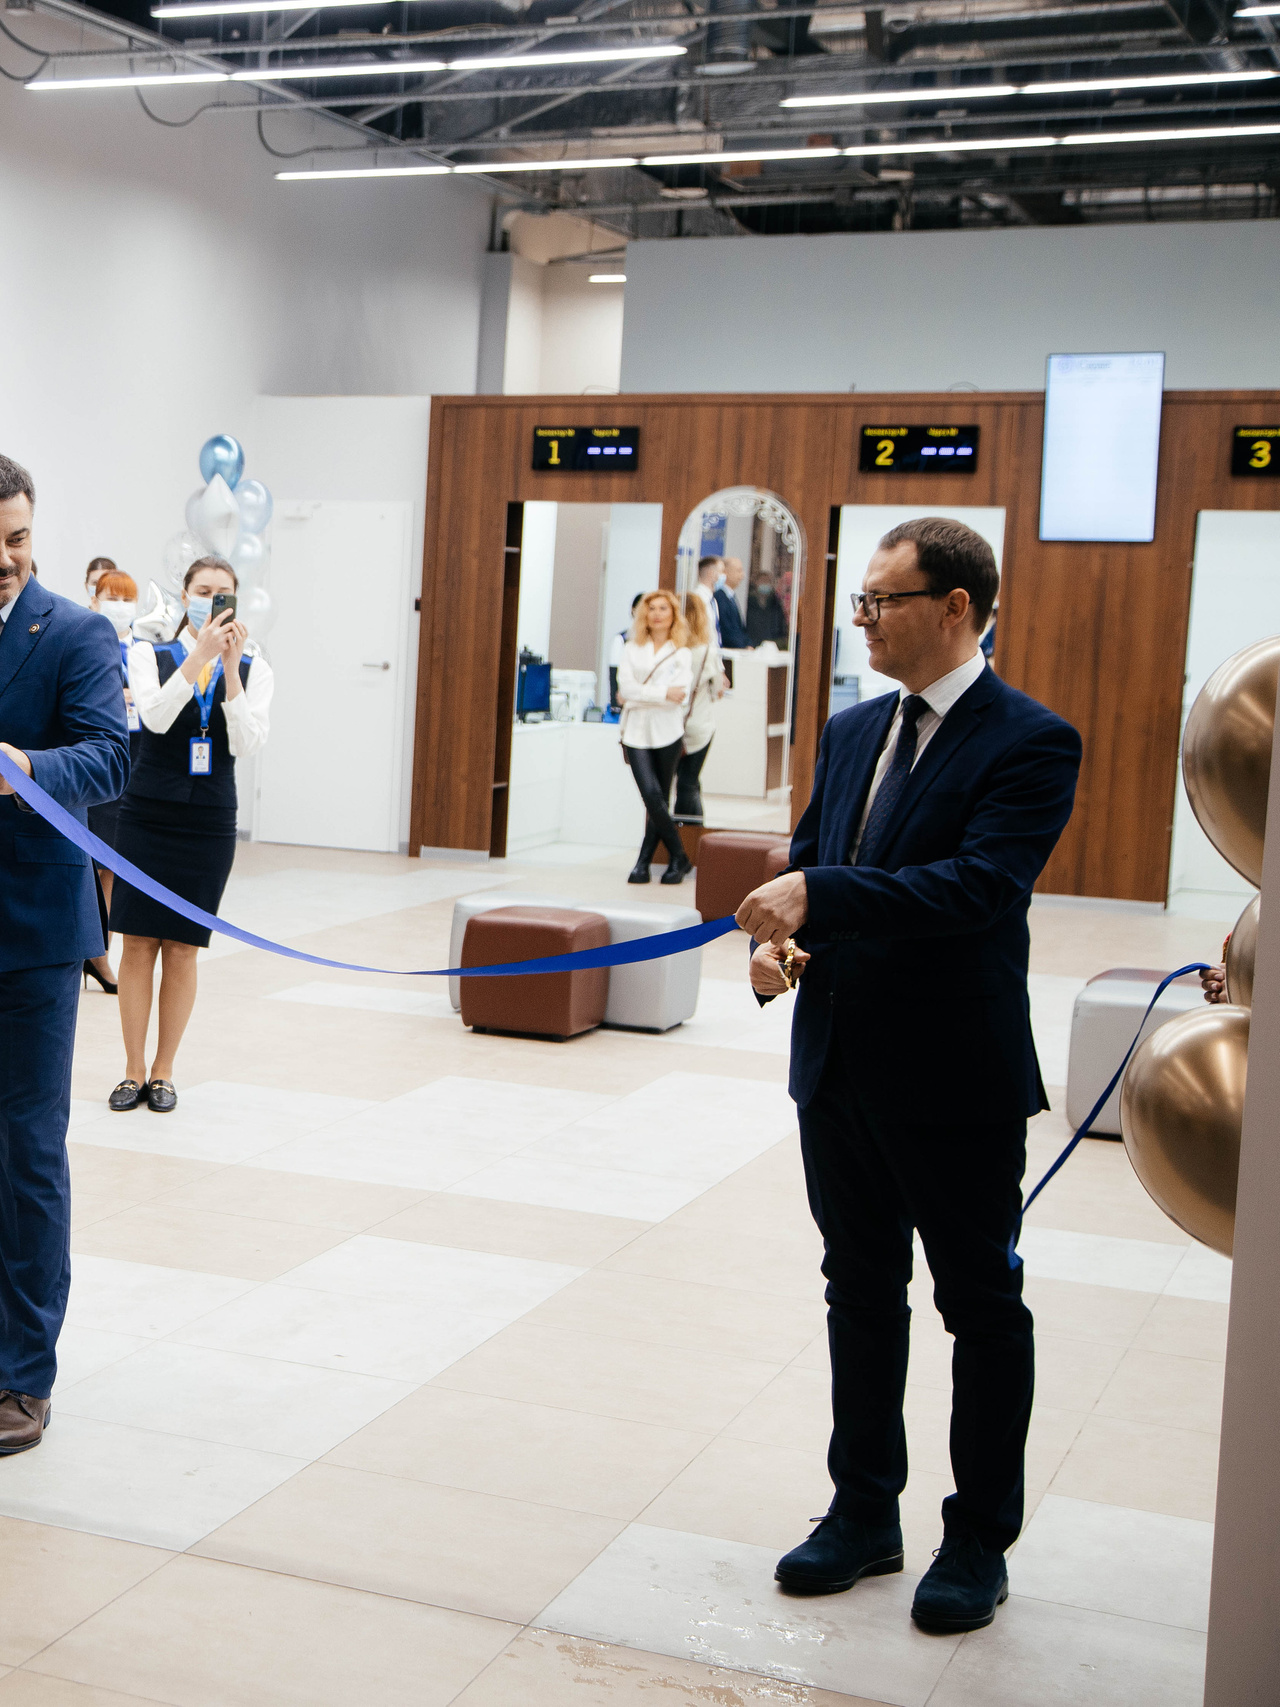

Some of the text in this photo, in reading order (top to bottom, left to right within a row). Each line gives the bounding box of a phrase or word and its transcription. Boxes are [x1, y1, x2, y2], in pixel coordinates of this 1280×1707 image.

[548, 440, 561, 465] 1
[875, 439, 895, 466] 2
[1249, 440, 1271, 468] 3
